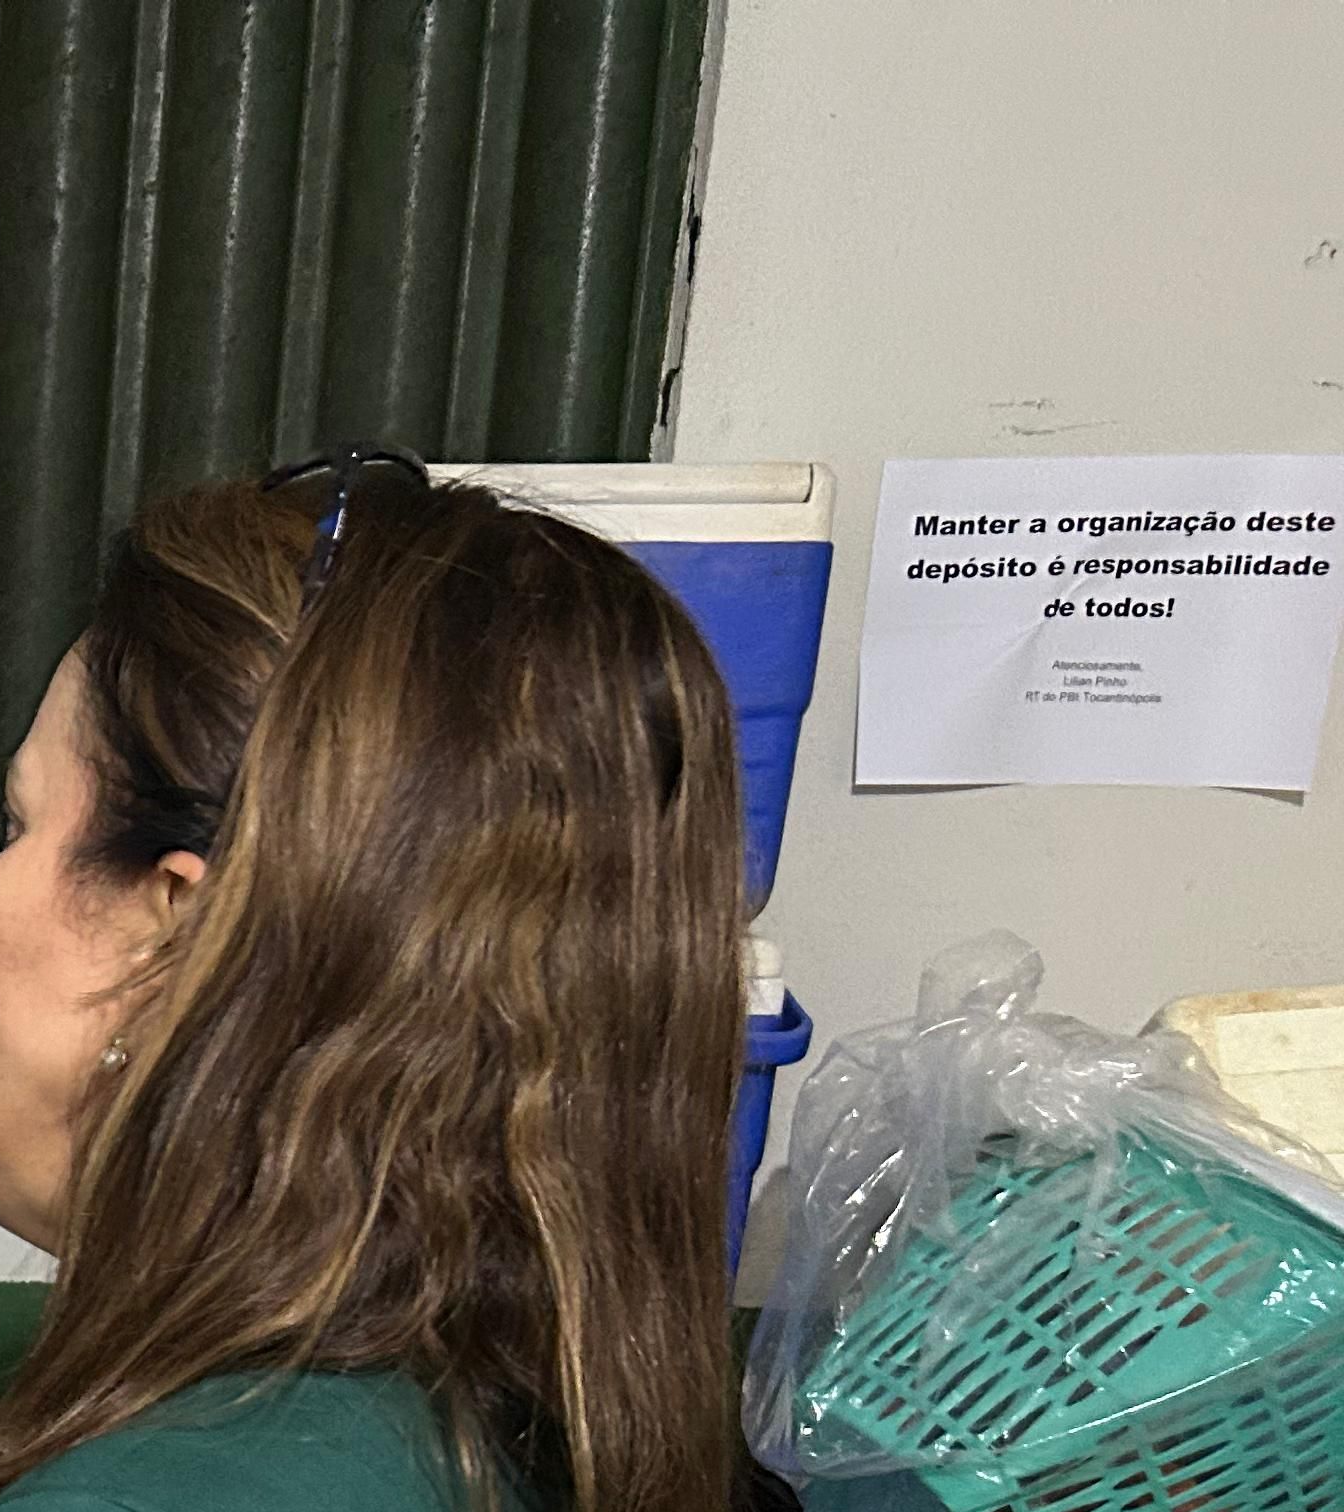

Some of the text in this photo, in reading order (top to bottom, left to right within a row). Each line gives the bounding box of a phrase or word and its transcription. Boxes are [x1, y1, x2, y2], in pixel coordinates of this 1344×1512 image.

[914, 510, 1336, 539] Manter a organização deste
[907, 553, 1331, 584] depósito é responsabilidade
[1043, 597, 1176, 619] de todos!
